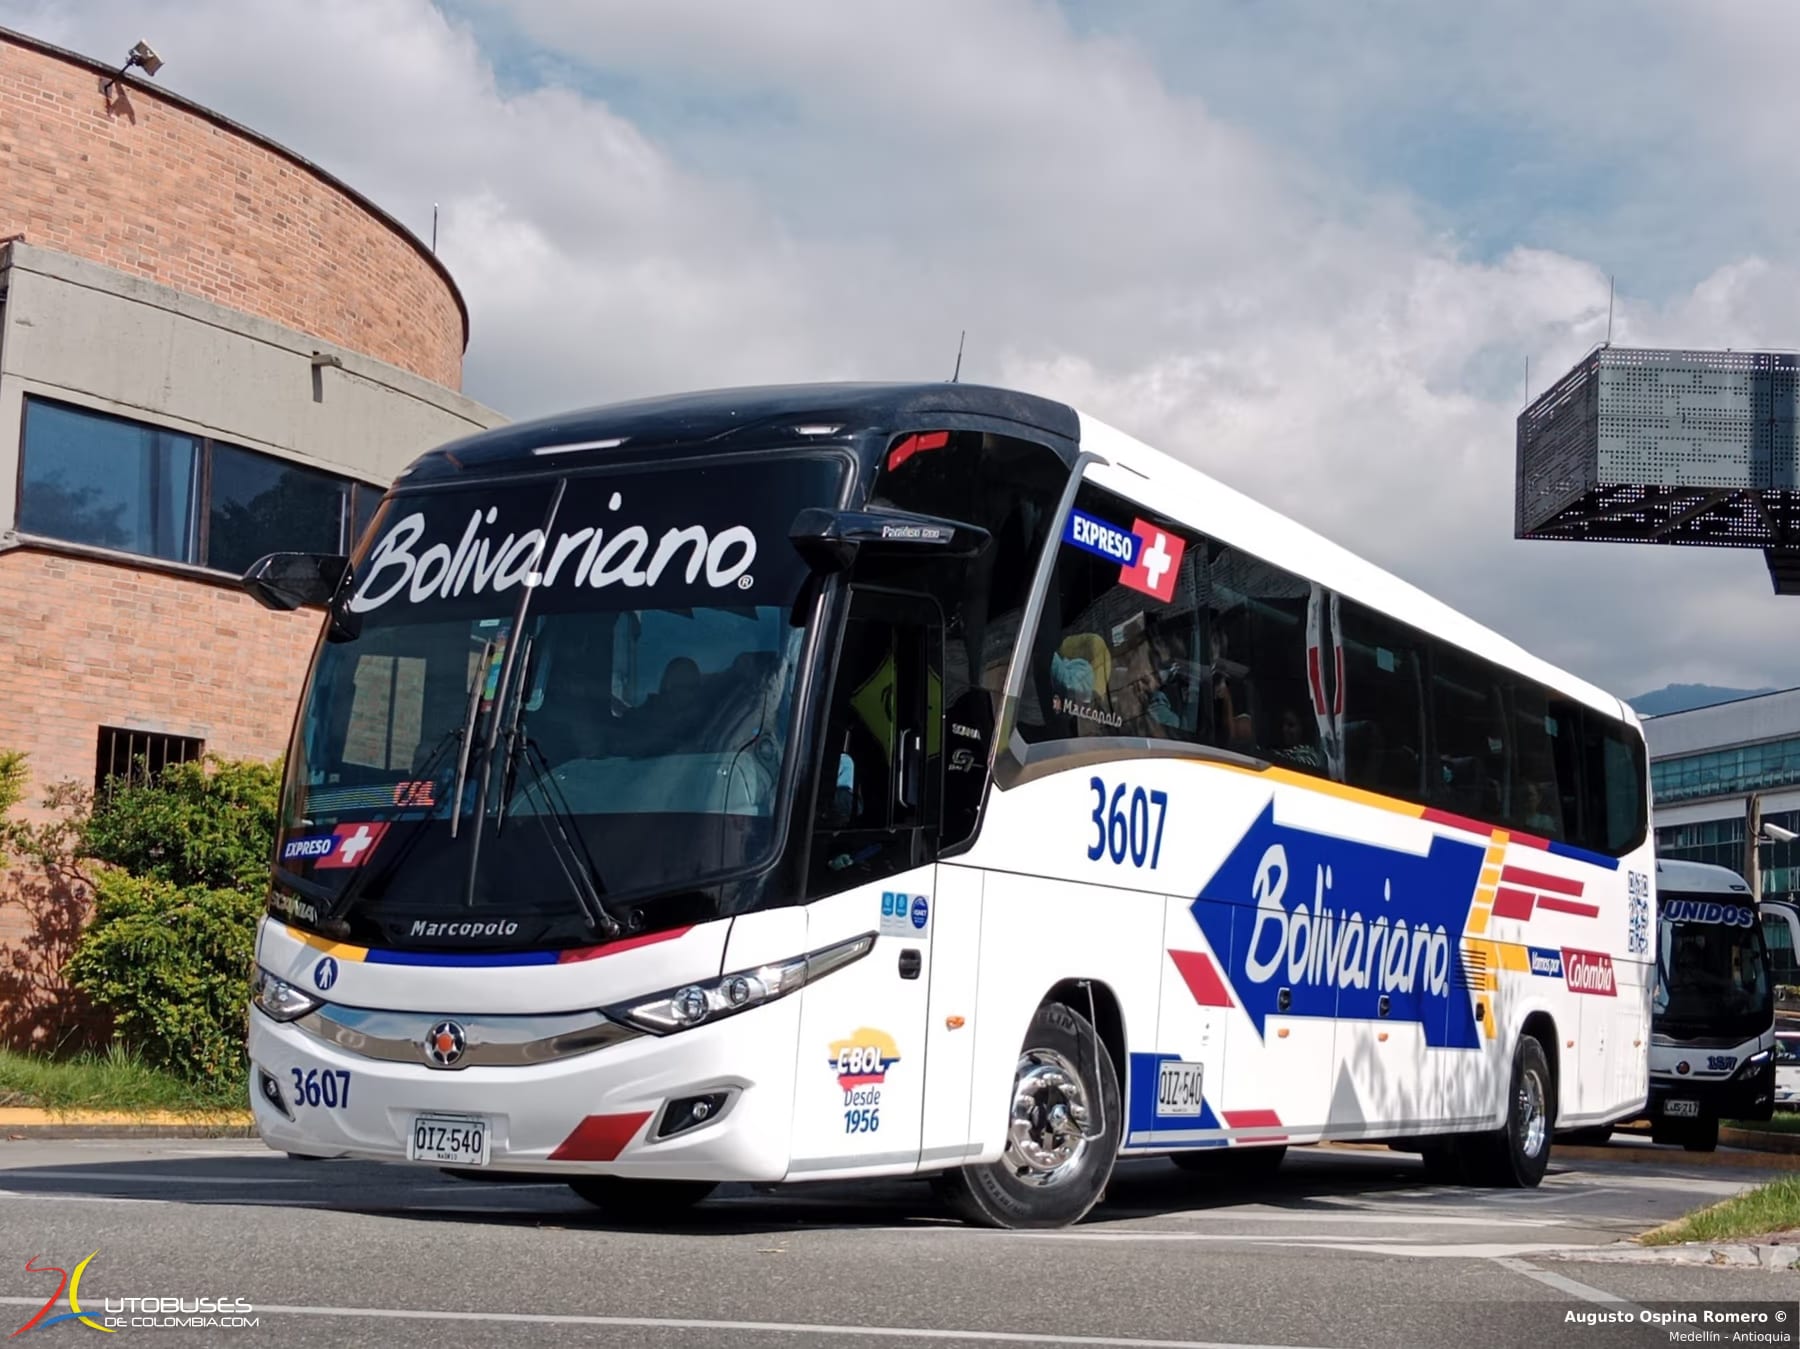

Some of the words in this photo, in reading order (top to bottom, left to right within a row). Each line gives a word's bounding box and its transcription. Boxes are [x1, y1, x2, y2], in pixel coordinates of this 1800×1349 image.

[1073, 515, 1132, 561] EXPRESO
[1087, 776, 1168, 870] 3607
[284, 838, 332, 858] EXPRESO
[1663, 900, 1754, 928] UNIDOS
[410, 919, 519, 938] Marcopolo
[1568, 953, 1612, 992] Colombia
[291, 1067, 351, 1108] 3607
[844, 1085, 881, 1107] Desde
[844, 1107, 880, 1134] 1956
